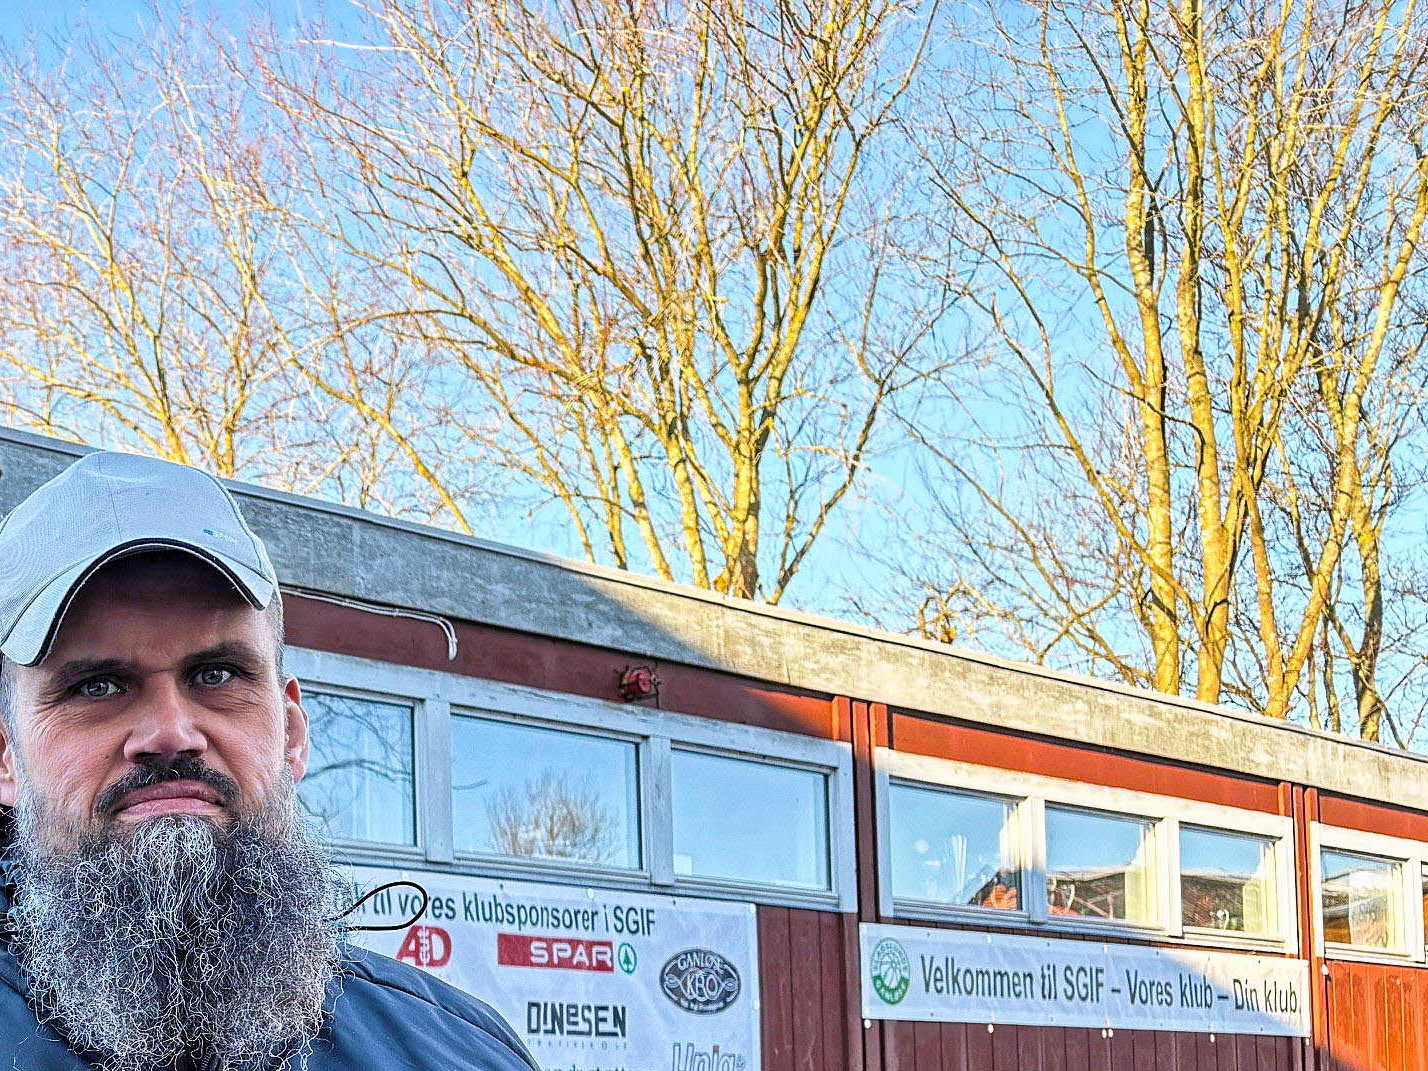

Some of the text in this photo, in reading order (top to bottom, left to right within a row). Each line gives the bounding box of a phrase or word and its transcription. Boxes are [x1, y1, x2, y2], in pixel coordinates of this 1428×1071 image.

[463, 891, 599, 931] klubsponsorer
[603, 904, 610, 932] i
[614, 905, 656, 937] SGIF
[530, 940, 613, 968] SPAR
[921, 954, 1035, 999] Velkommen
[1041, 963, 1058, 1000] til
[1064, 964, 1104, 1003] SGIF
[1126, 969, 1173, 1006] Vores
[1179, 973, 1213, 1009] klub
[1233, 978, 1260, 1012] Din
